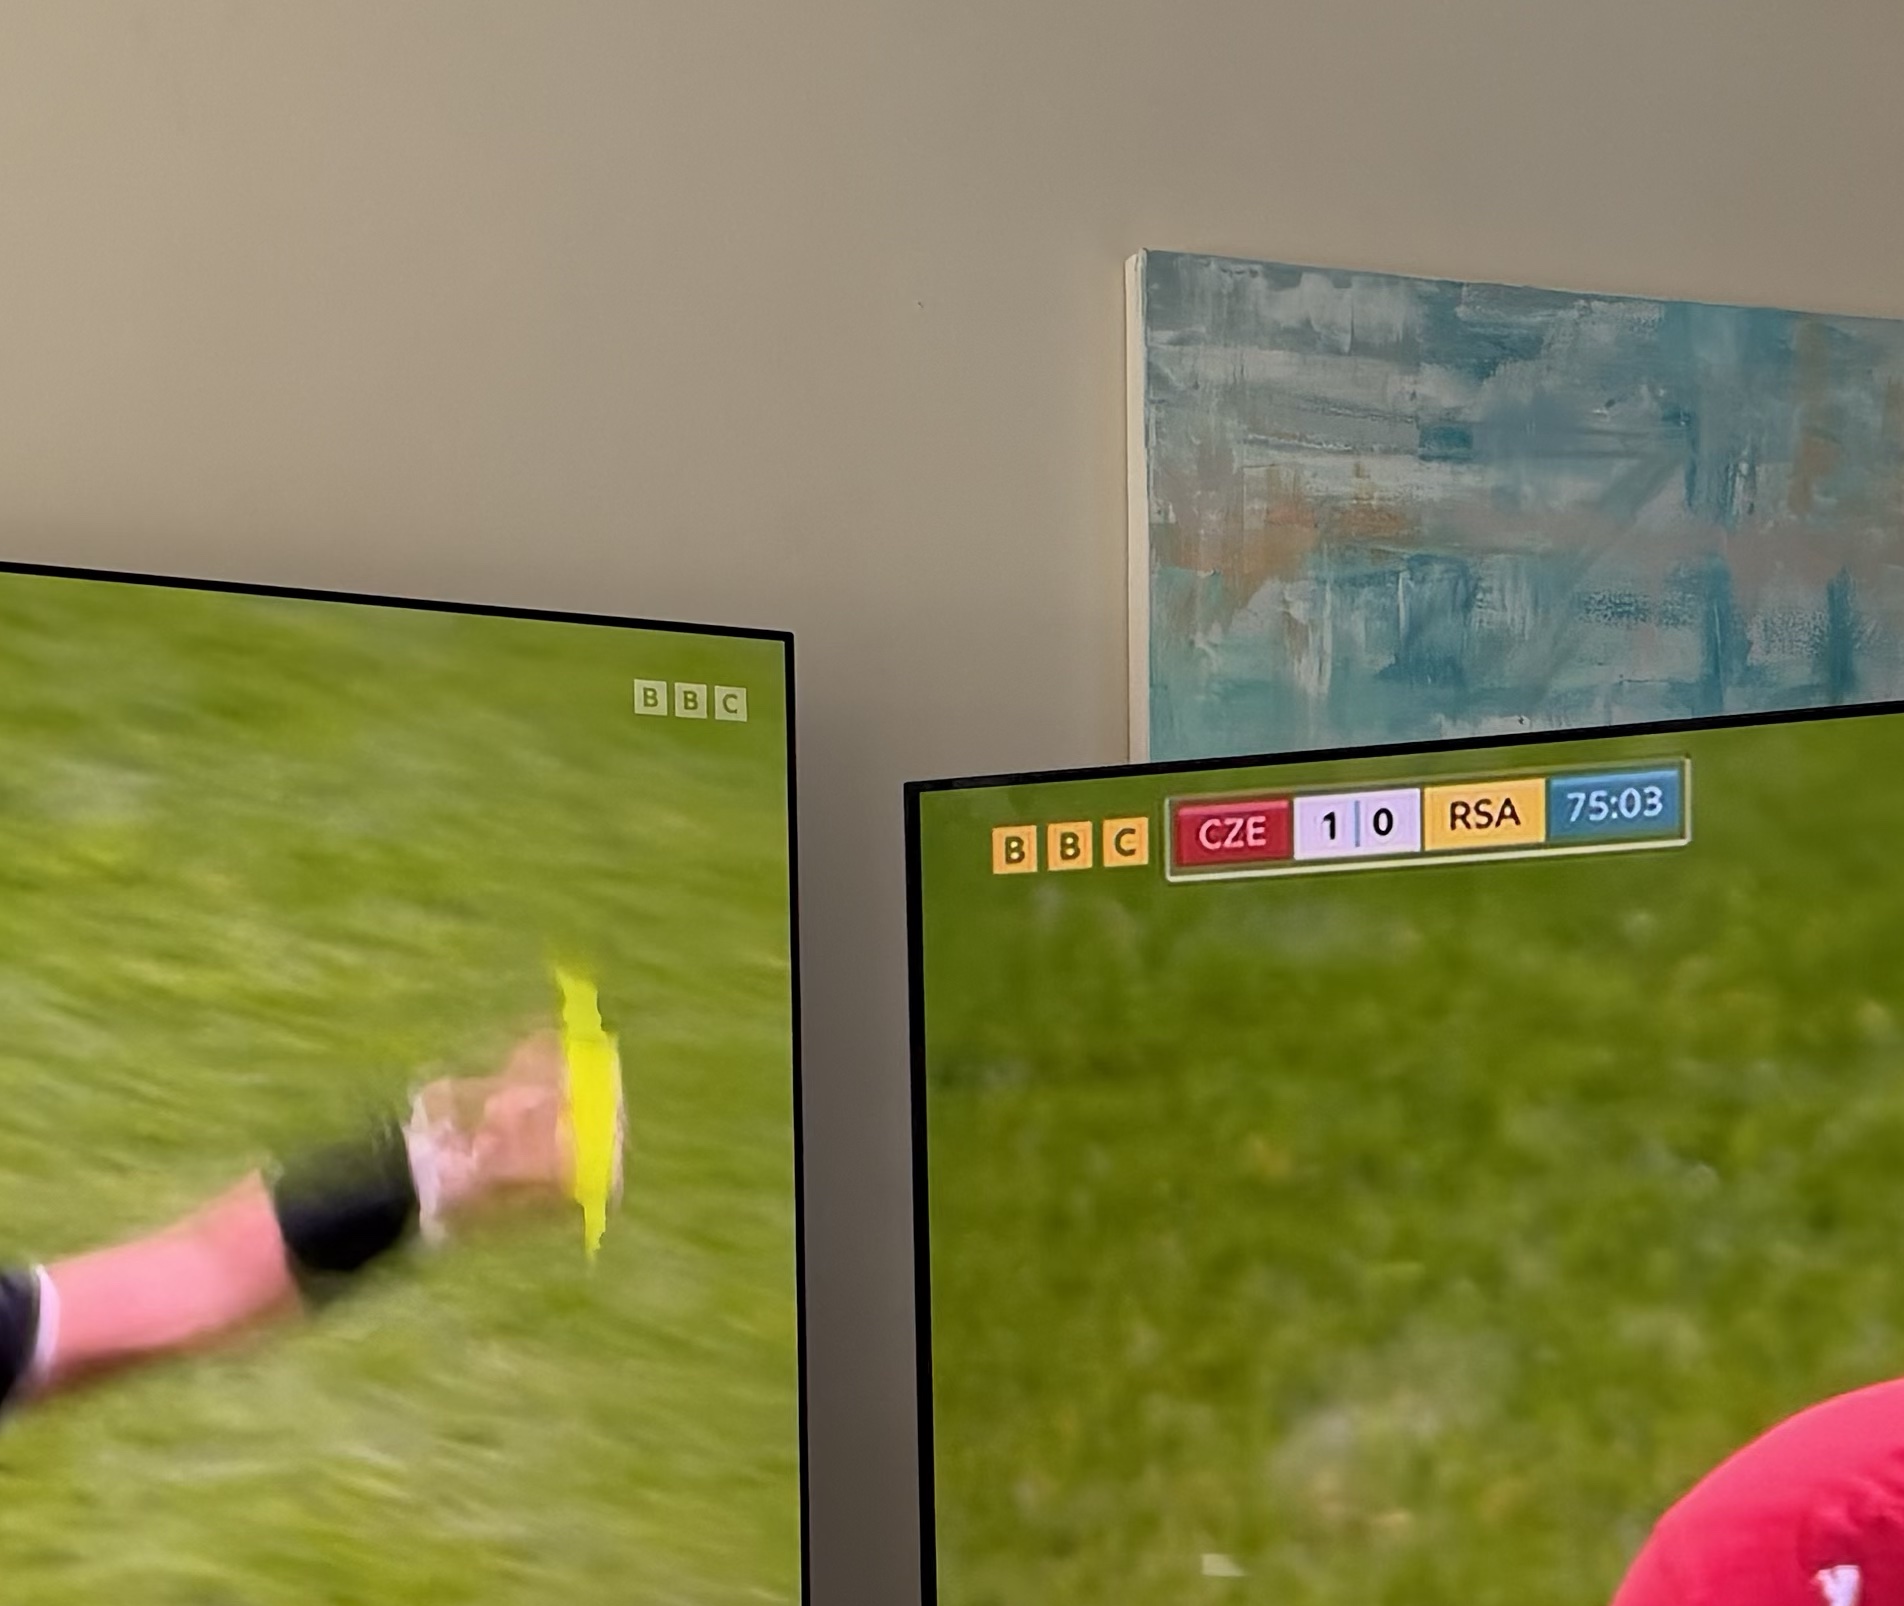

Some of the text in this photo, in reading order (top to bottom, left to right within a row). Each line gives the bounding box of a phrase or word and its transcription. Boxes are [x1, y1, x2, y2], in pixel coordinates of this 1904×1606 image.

[1198, 786, 1664, 850] CZE 1 0 RSA 75:03
